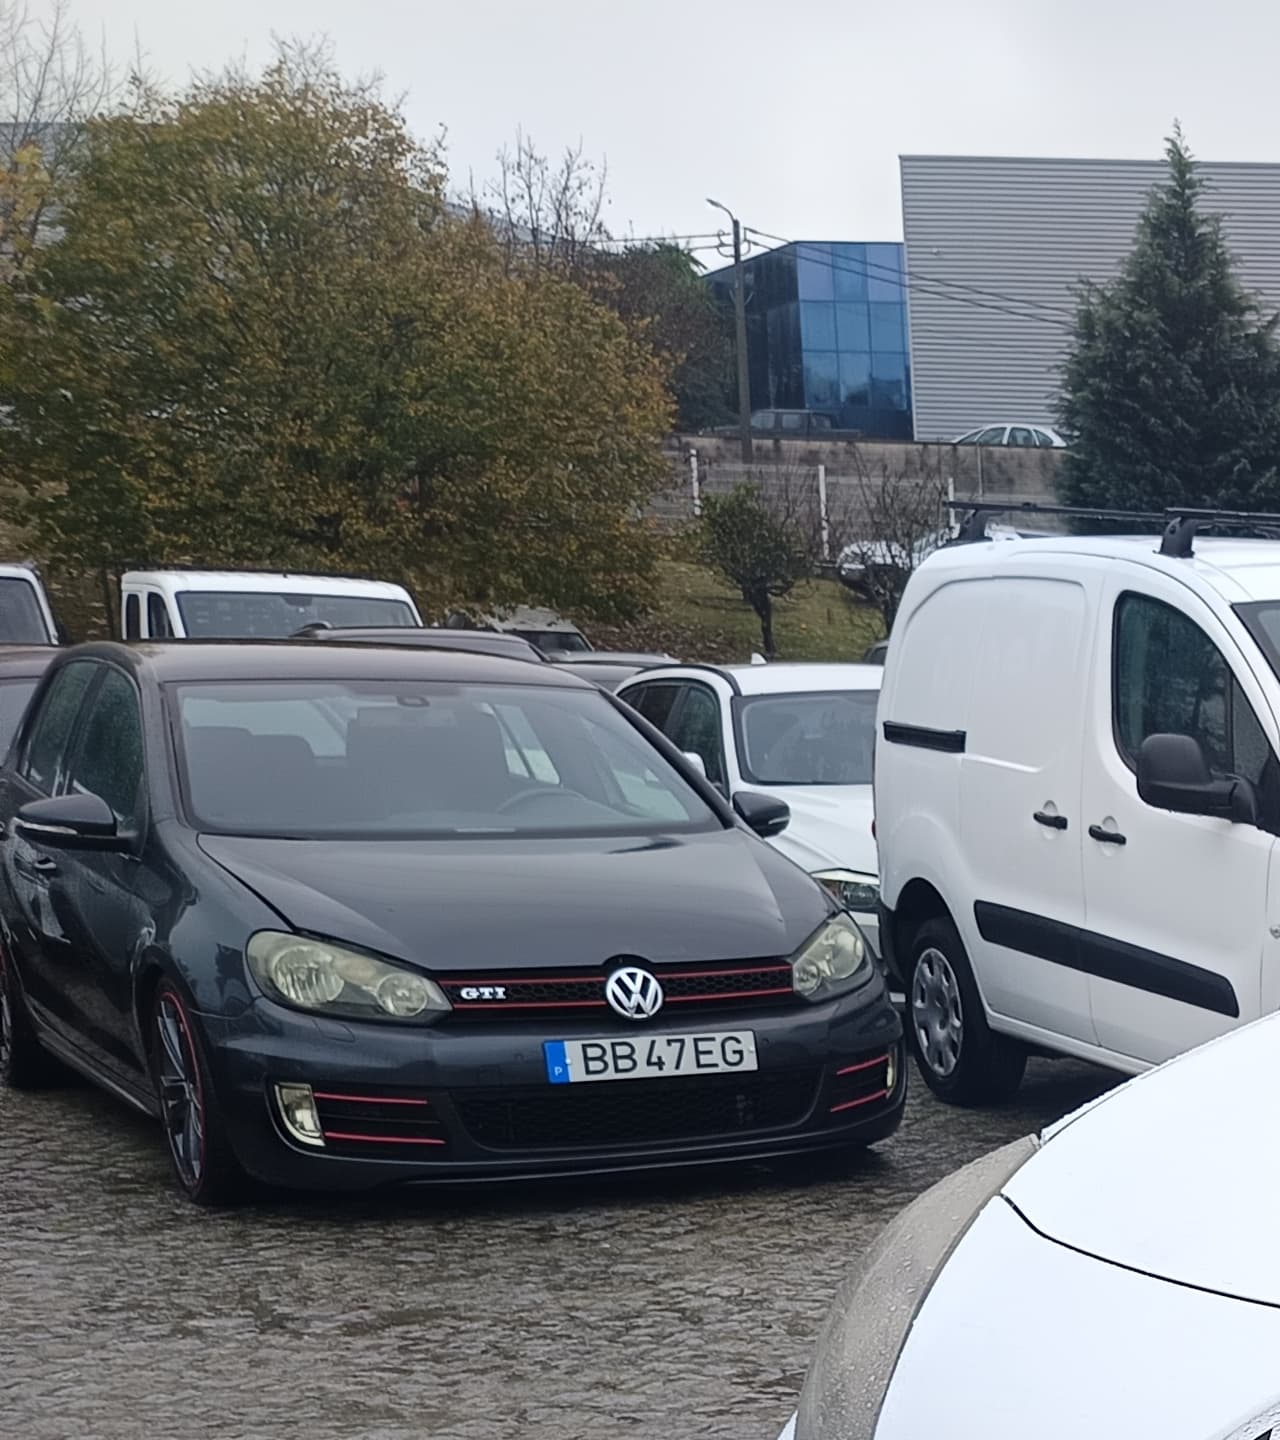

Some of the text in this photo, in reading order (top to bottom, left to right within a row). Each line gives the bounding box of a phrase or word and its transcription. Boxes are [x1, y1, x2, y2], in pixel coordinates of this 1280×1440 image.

[460, 986, 506, 1000] GTI
[607, 968, 662, 1018] VW
[554, 1066, 563, 1076] P
